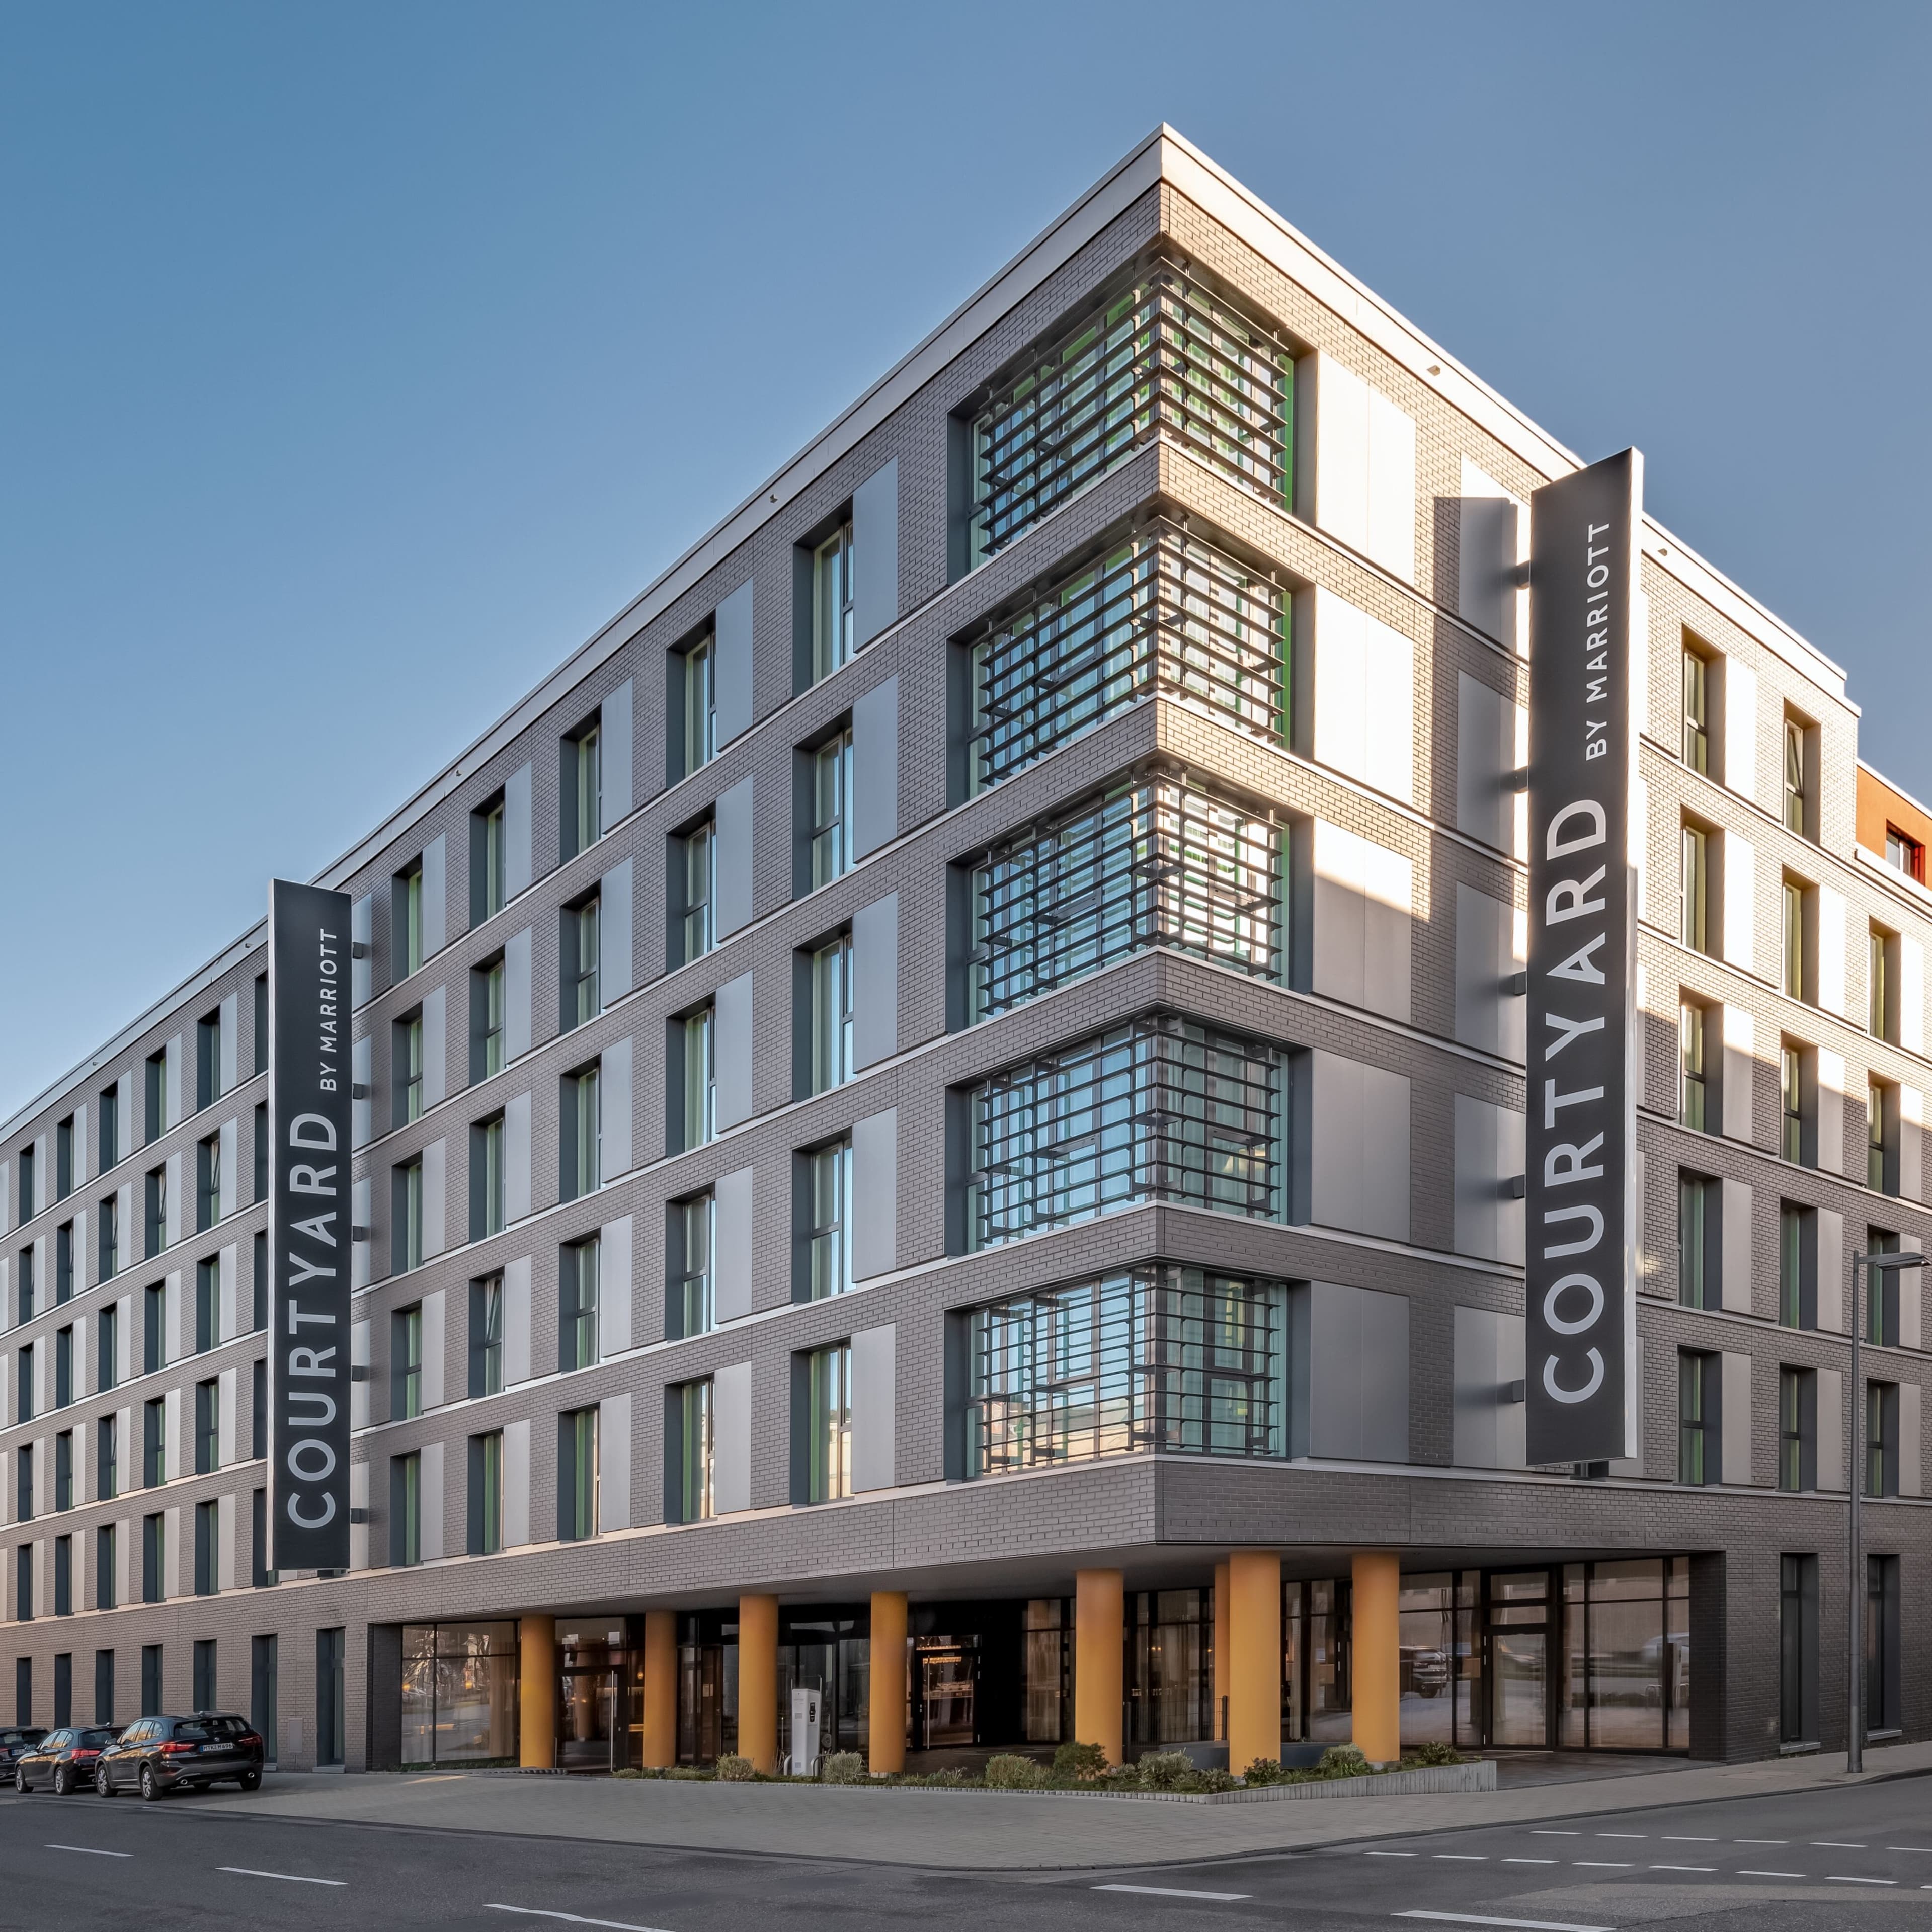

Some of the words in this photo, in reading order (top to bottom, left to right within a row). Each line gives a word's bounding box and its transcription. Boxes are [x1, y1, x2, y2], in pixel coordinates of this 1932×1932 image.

[1586, 523, 1609, 703] MARRIOTT
[1586, 720, 1607, 761] BY
[319, 927, 337, 1053] MARRIOTT
[319, 1061, 337, 1092] BY
[1543, 799, 1606, 1403] COURTYARD
[287, 1113, 337, 1530] COURTYARD
